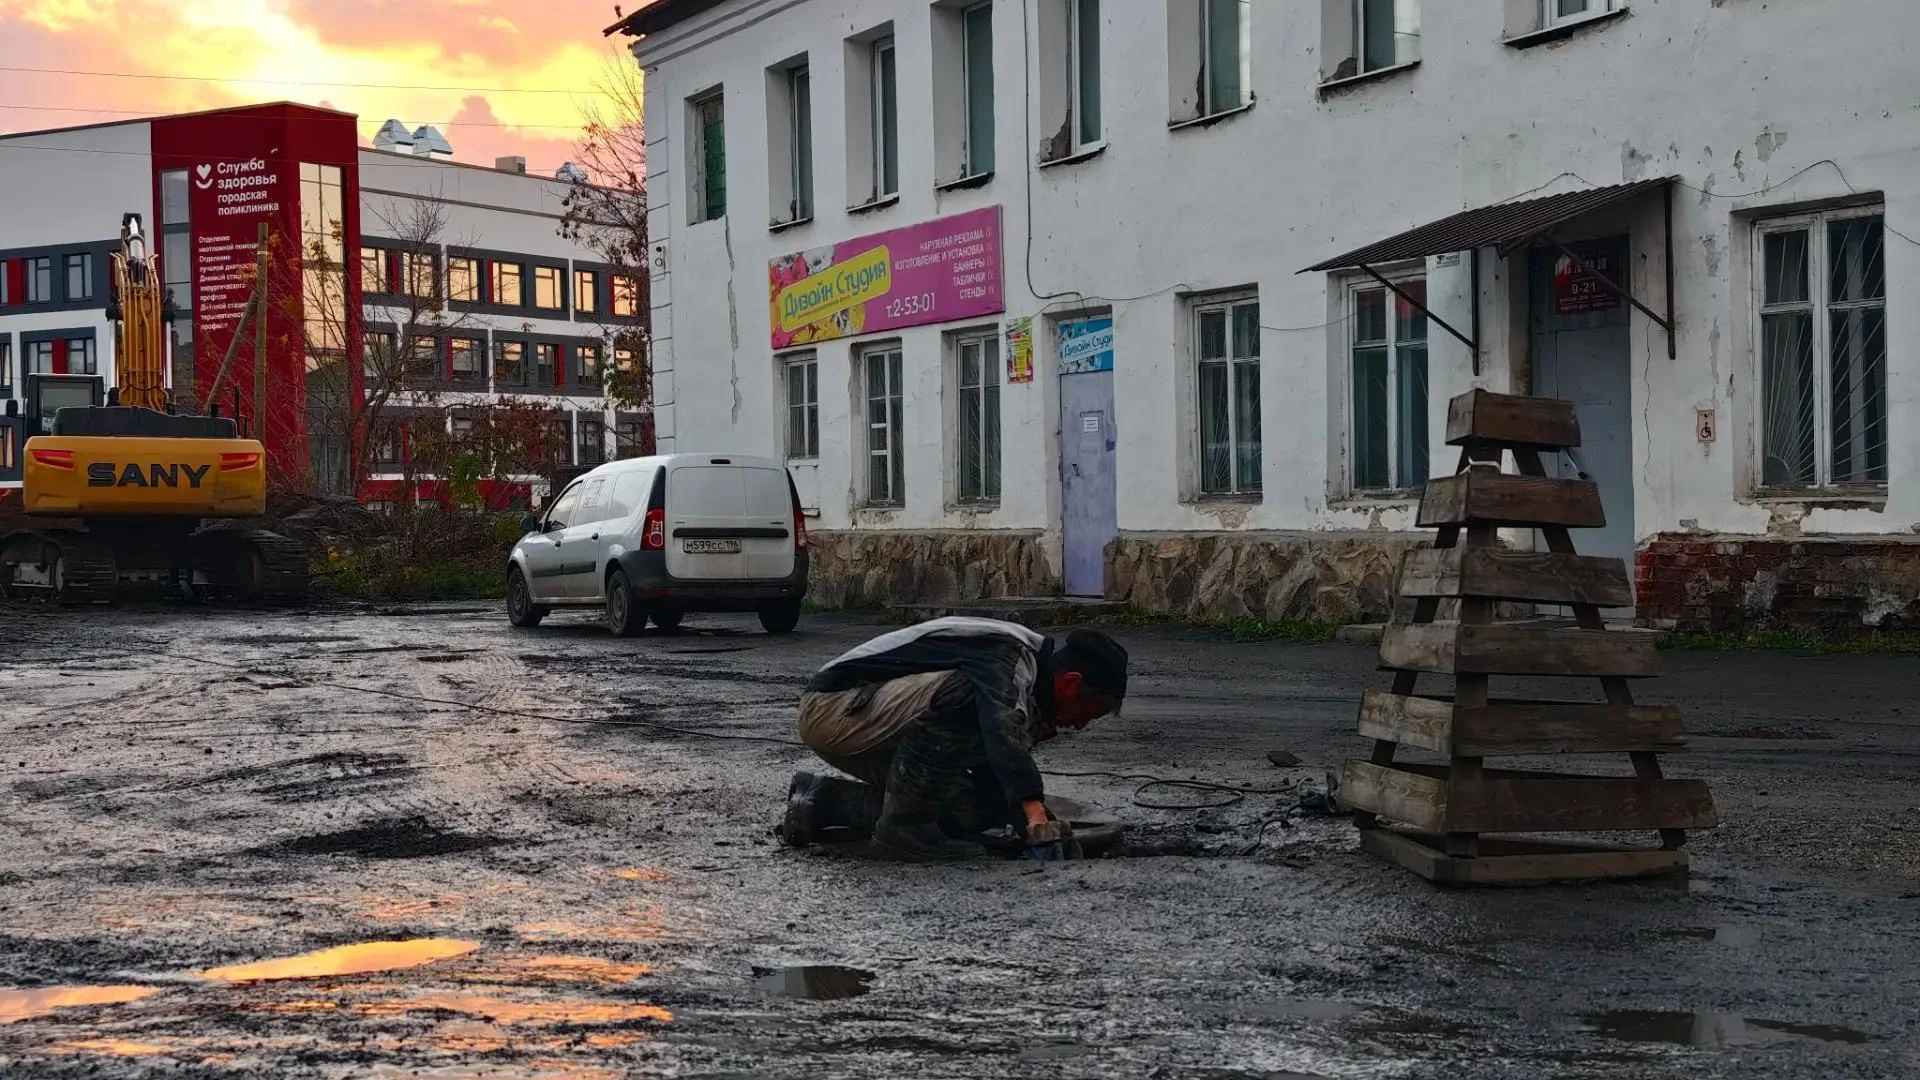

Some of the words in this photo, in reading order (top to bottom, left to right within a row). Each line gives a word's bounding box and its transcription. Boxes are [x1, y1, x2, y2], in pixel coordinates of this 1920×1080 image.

[217, 157, 265, 175] Служба
[217, 174, 277, 190] здоровья
[217, 190, 268, 204] городская
[218, 201, 279, 216] поликлиника
[919, 236, 953, 252] НАРУЖНАЯ
[954, 229, 984, 244] РЕКЛАМА
[895, 252, 941, 270] ИЗГОТОВЛЕНИЕ
[948, 243, 985, 260] УСТАНОВКА
[954, 257, 985, 273] БАННЕРЫ
[836, 261, 887, 297] Студия
[953, 271, 986, 287] ТАБЛИЧКИ
[960, 285, 986, 300] СТЕНДЫ
[87, 462, 211, 489] SANY
